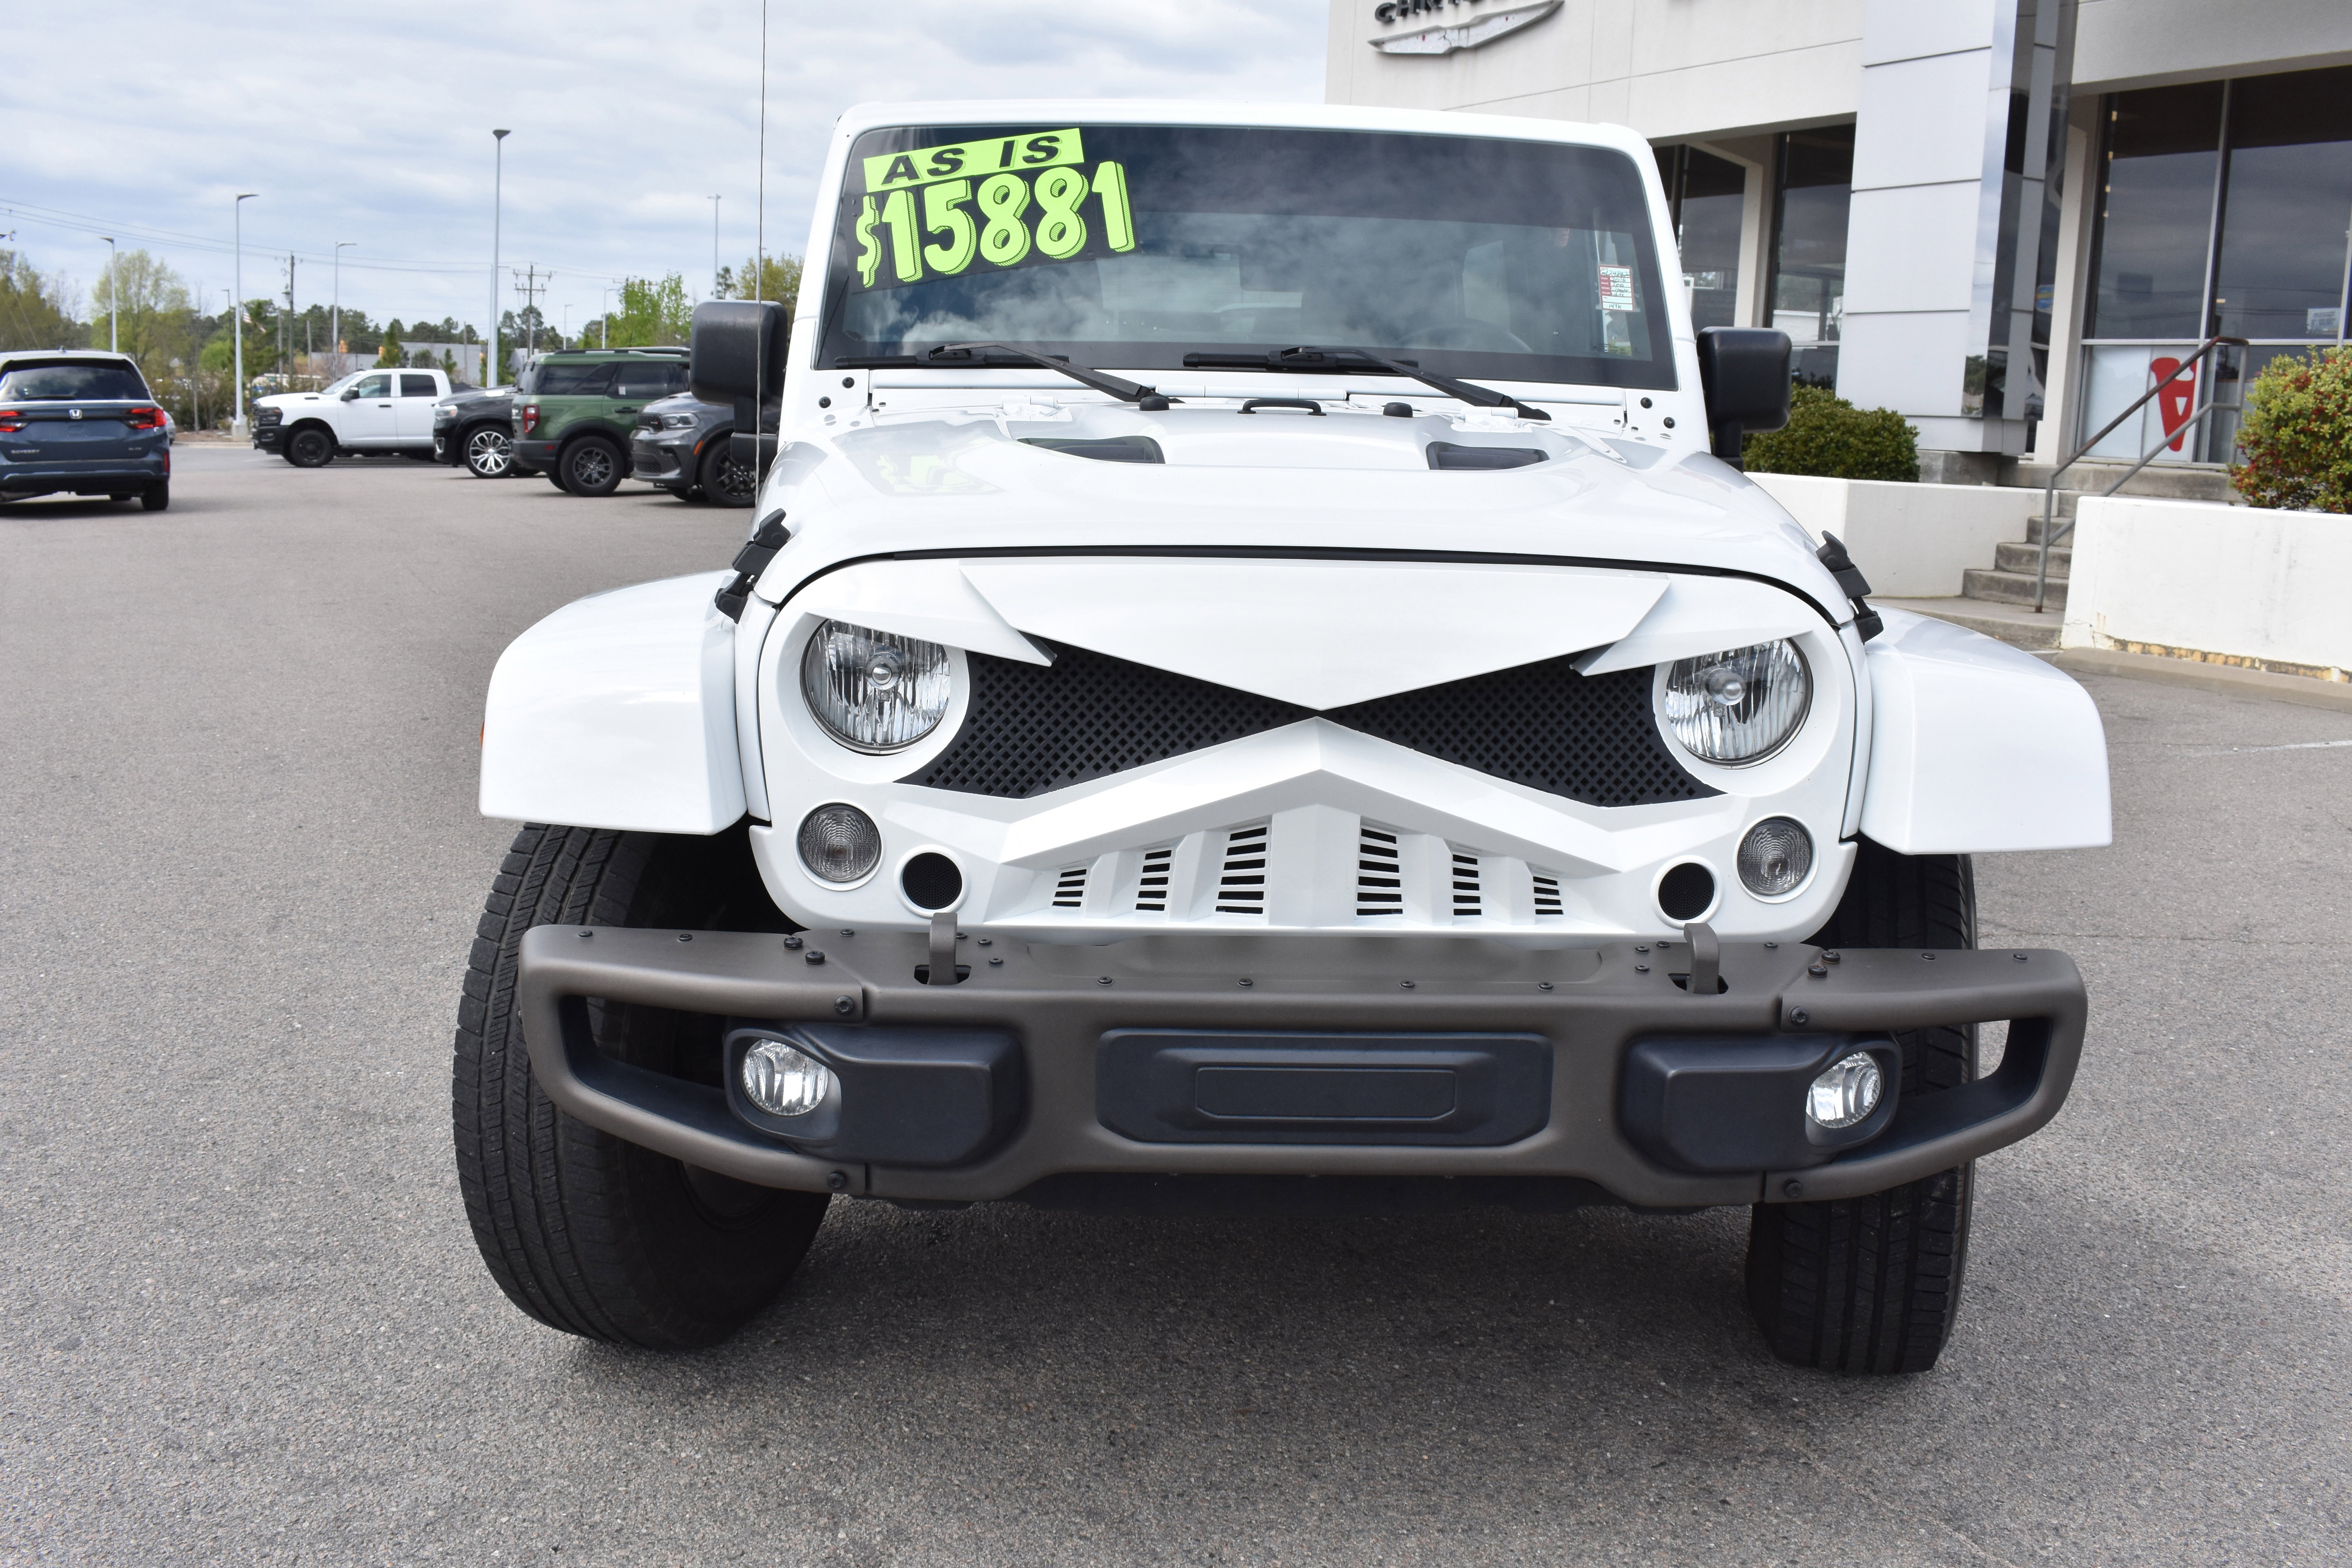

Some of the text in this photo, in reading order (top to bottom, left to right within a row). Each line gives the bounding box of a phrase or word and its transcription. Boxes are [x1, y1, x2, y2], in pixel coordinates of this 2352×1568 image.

[881, 135, 1062, 187] AS IS
[855, 161, 1135, 288] $15881
